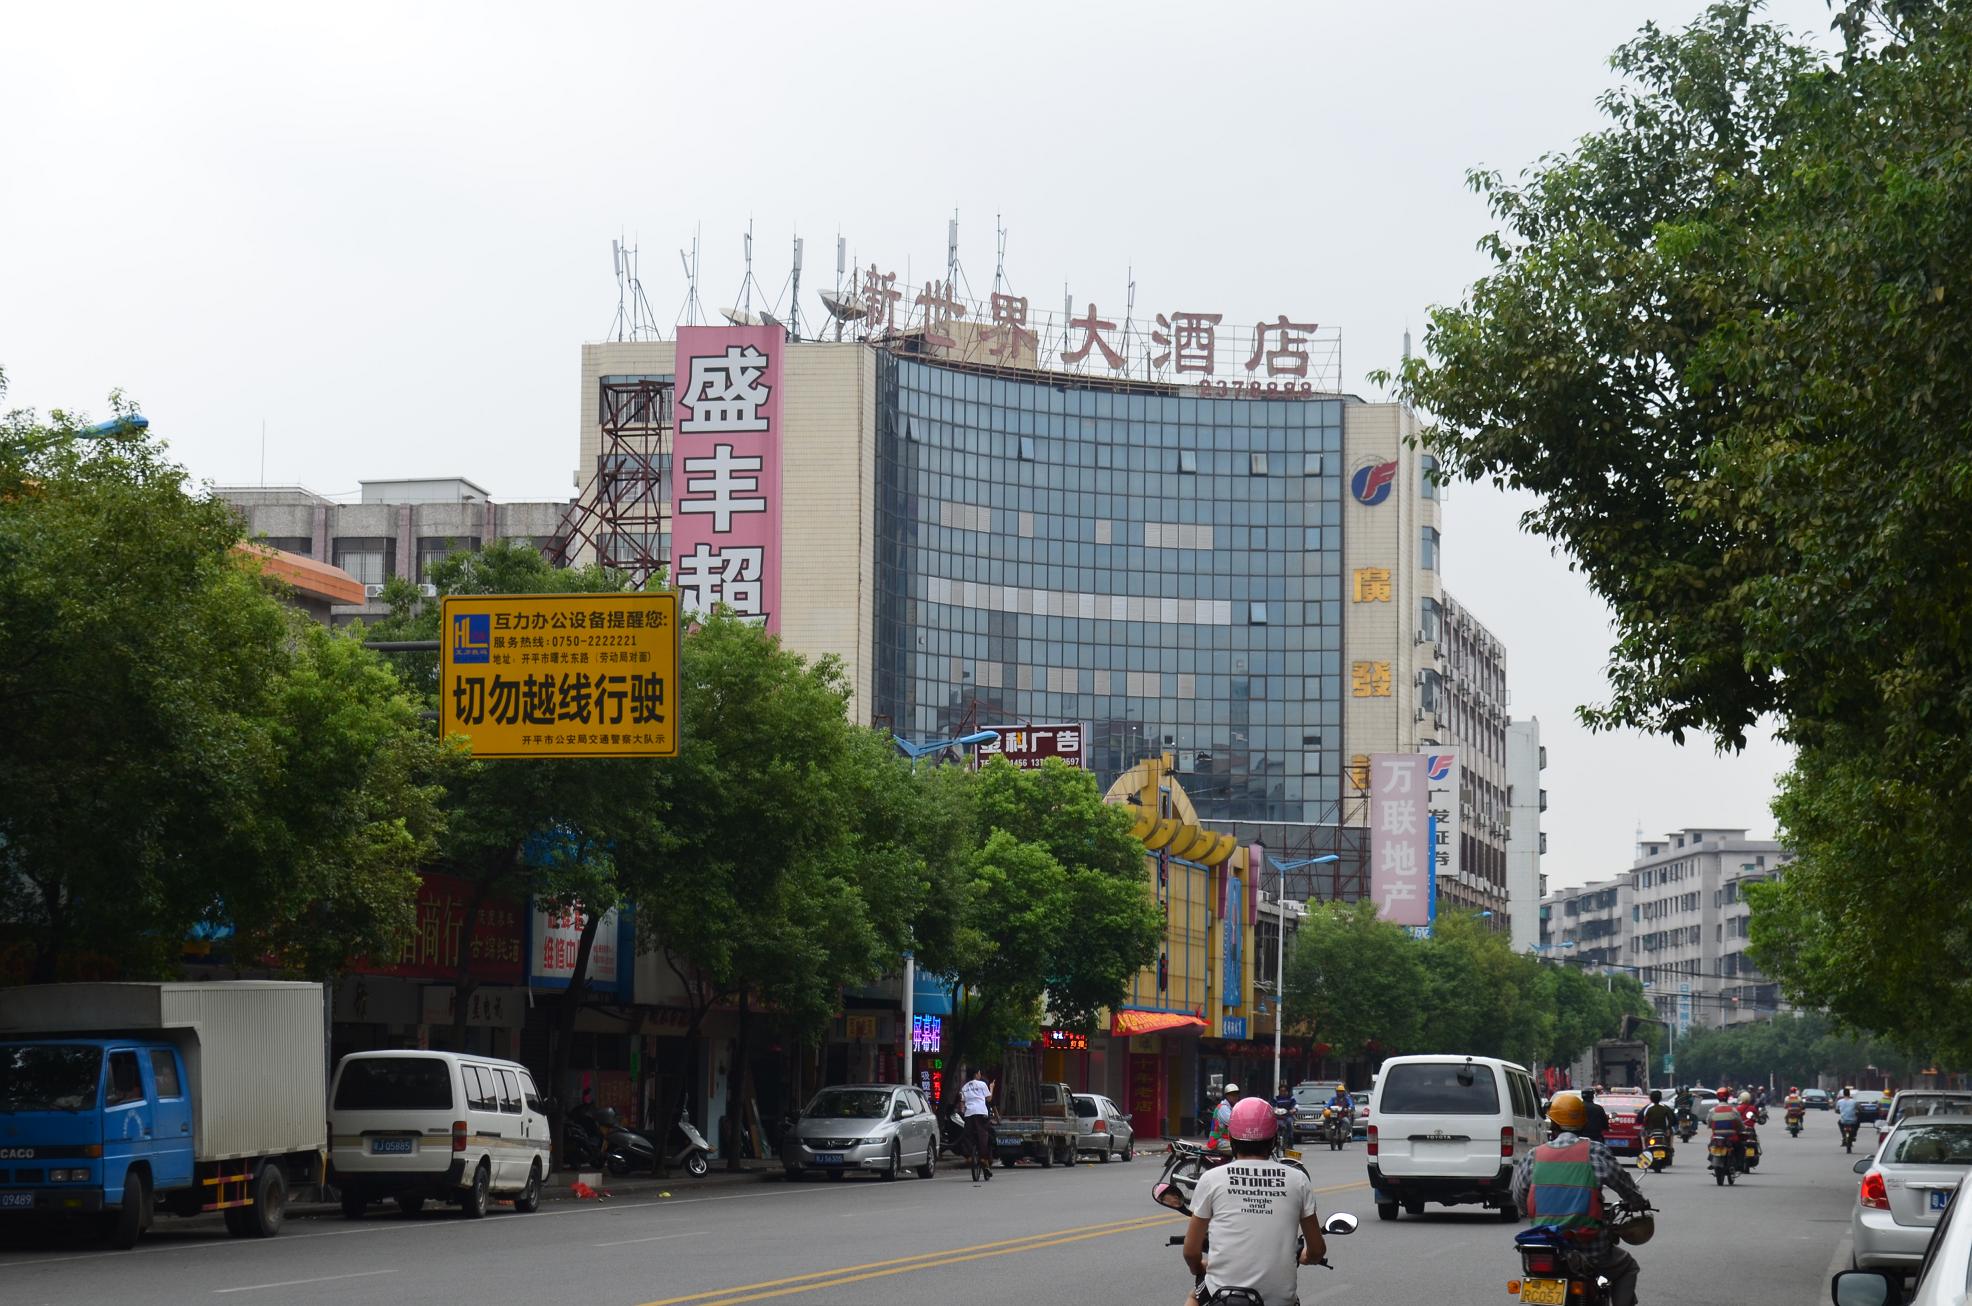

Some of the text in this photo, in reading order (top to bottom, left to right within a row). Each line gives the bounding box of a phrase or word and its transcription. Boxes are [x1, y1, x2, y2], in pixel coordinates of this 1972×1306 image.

[864, 263, 1319, 378] 新世界大酒店
[494, 610, 668, 630] 互力办公设备提醒您:
[453, 671, 665, 726] 切勿越线行驶
[522, 733, 665, 746] 开平市公安局交通警察大队示
[1381, 760, 1418, 916] 万联地产
[544, 936, 581, 970] 维修中
[1227, 1167, 1286, 1177] ROLLING
[1229, 1176, 1286, 1188] STONES
[1228, 1188, 1288, 1197] woodmax
[1243, 1197, 1273, 1205] simple
